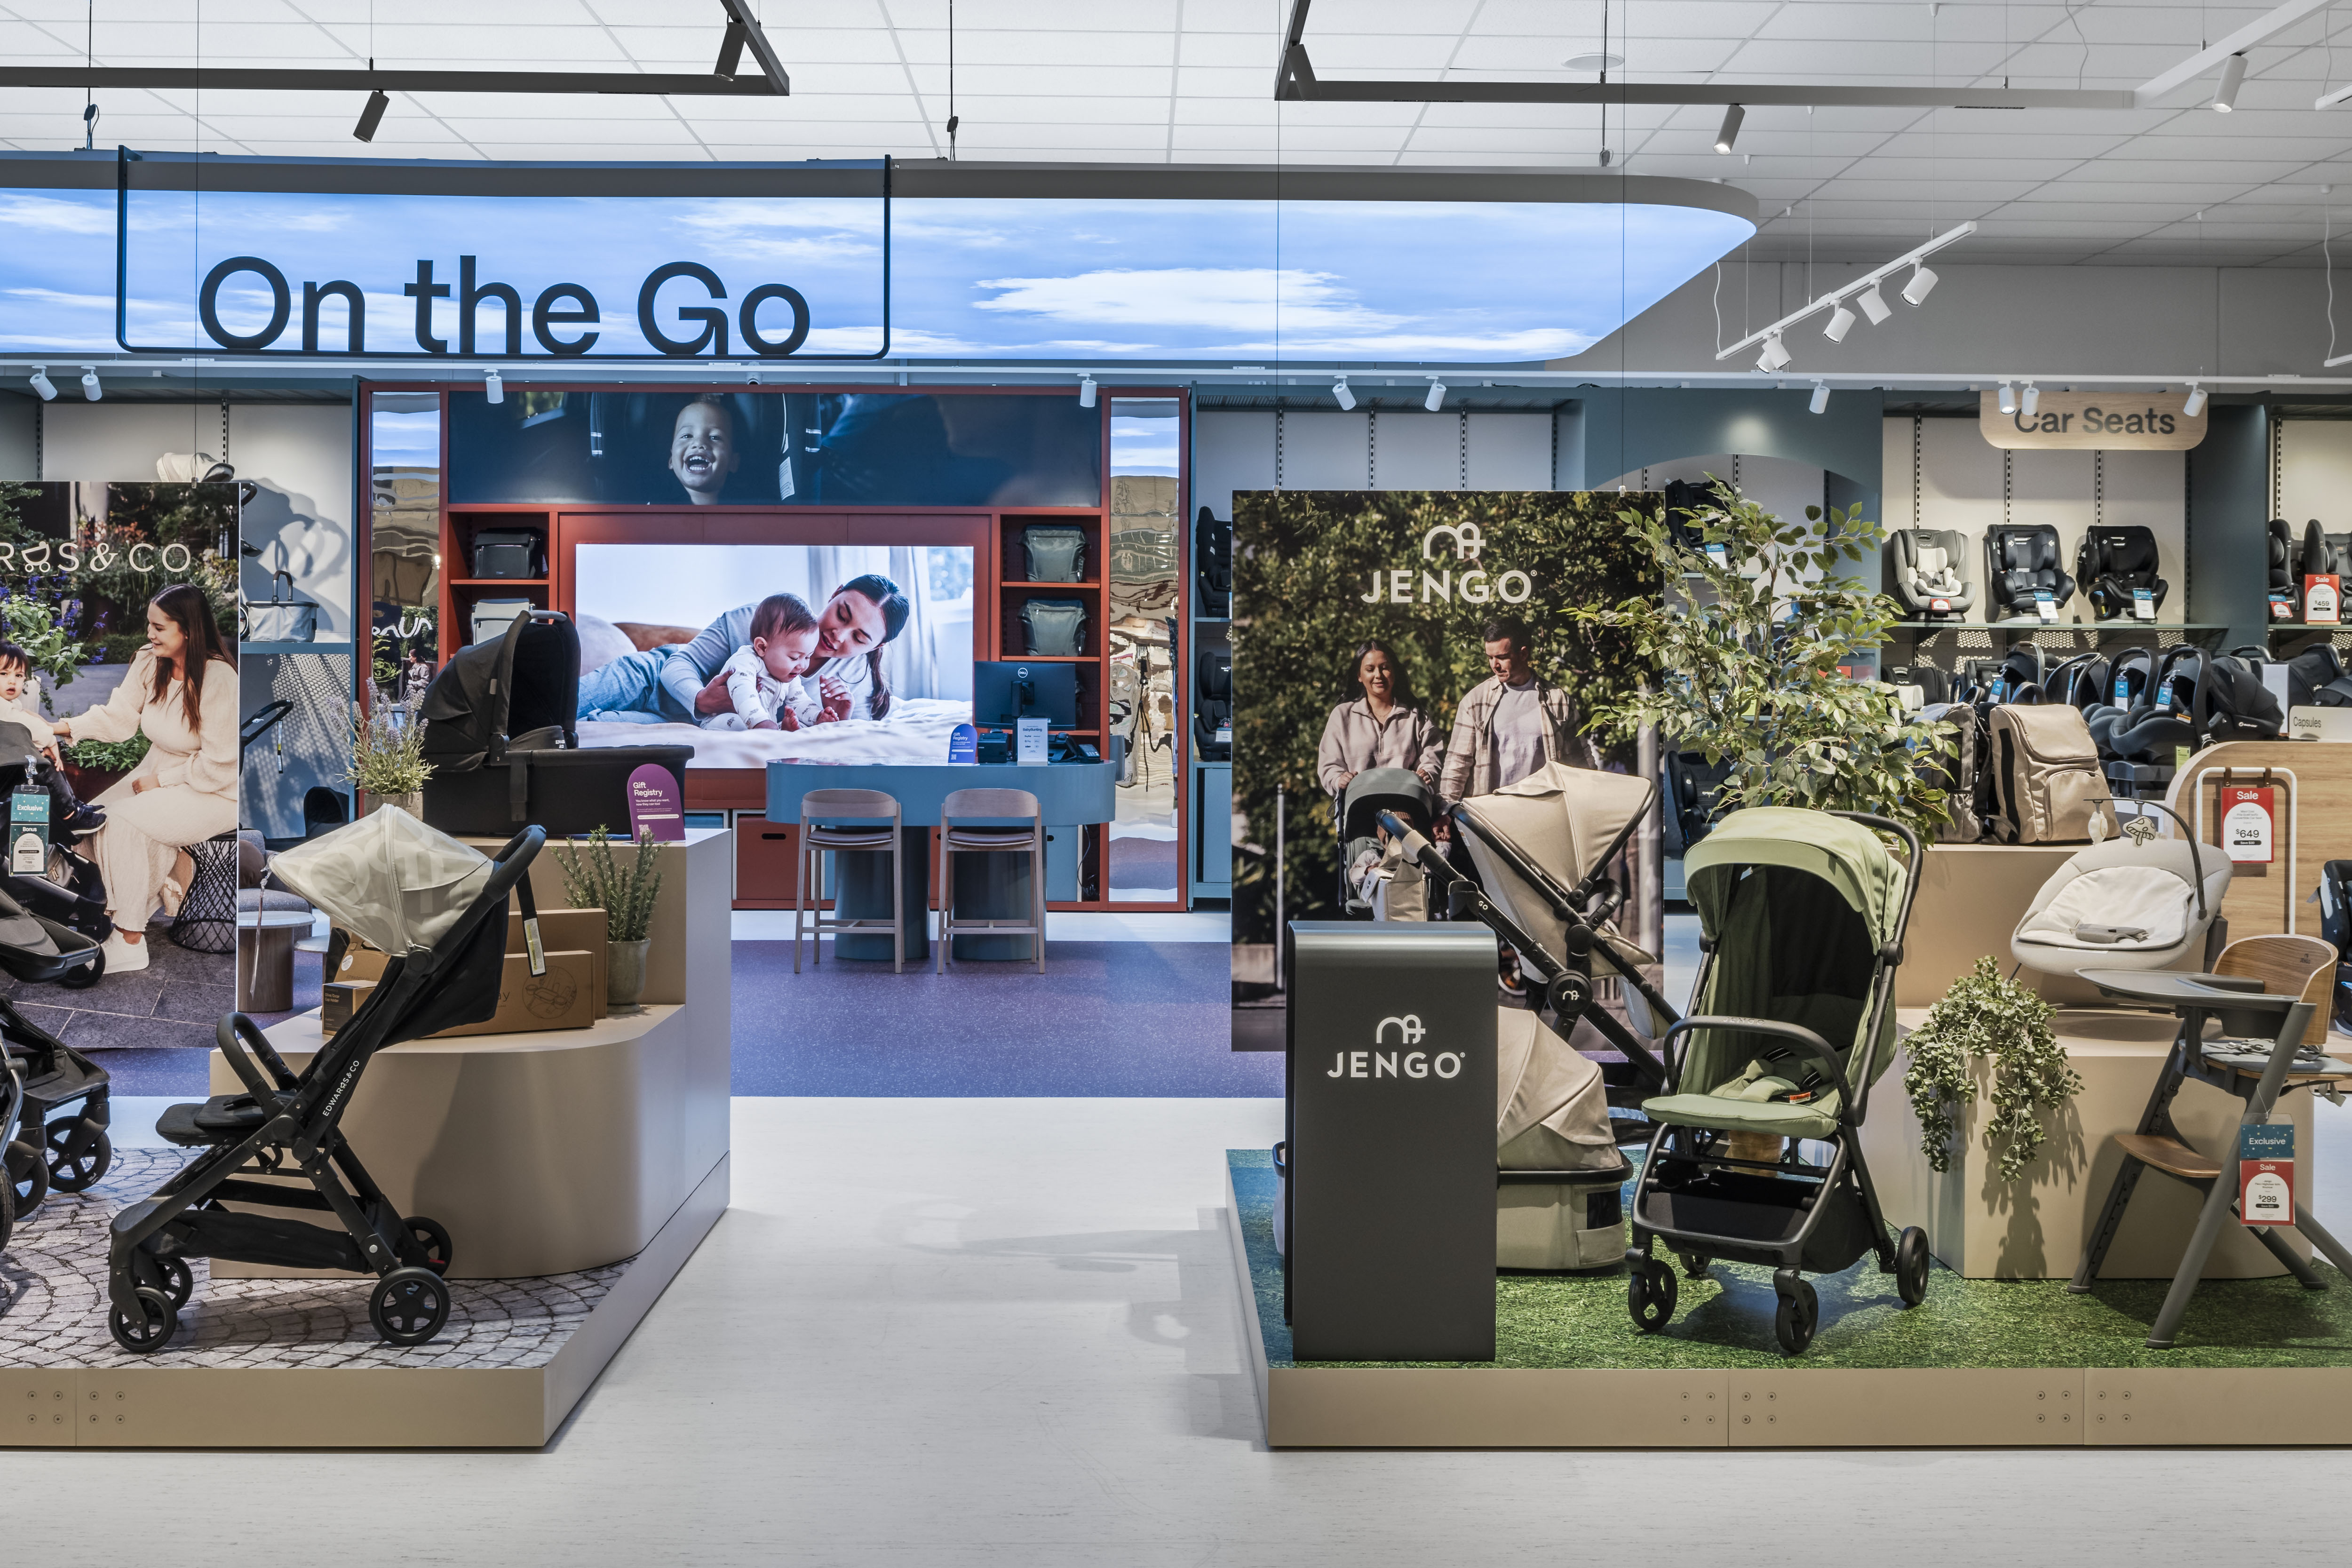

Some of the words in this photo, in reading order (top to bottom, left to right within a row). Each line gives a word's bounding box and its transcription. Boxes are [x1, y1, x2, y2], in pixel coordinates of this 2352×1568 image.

[199, 256, 365, 350] On
[404, 255, 600, 354] the
[637, 261, 810, 355] Go
[2014, 408, 2074, 433] Car
[2082, 407, 2175, 434] Seats
[1360, 570, 1532, 603] JENGO
[2293, 716, 2321, 729] Capsules
[634, 789, 662, 797] Registry
[2237, 791, 2258, 800] Sale
[2236, 829, 2259, 838] $649
[1327, 1051, 1461, 1078] JENGO
